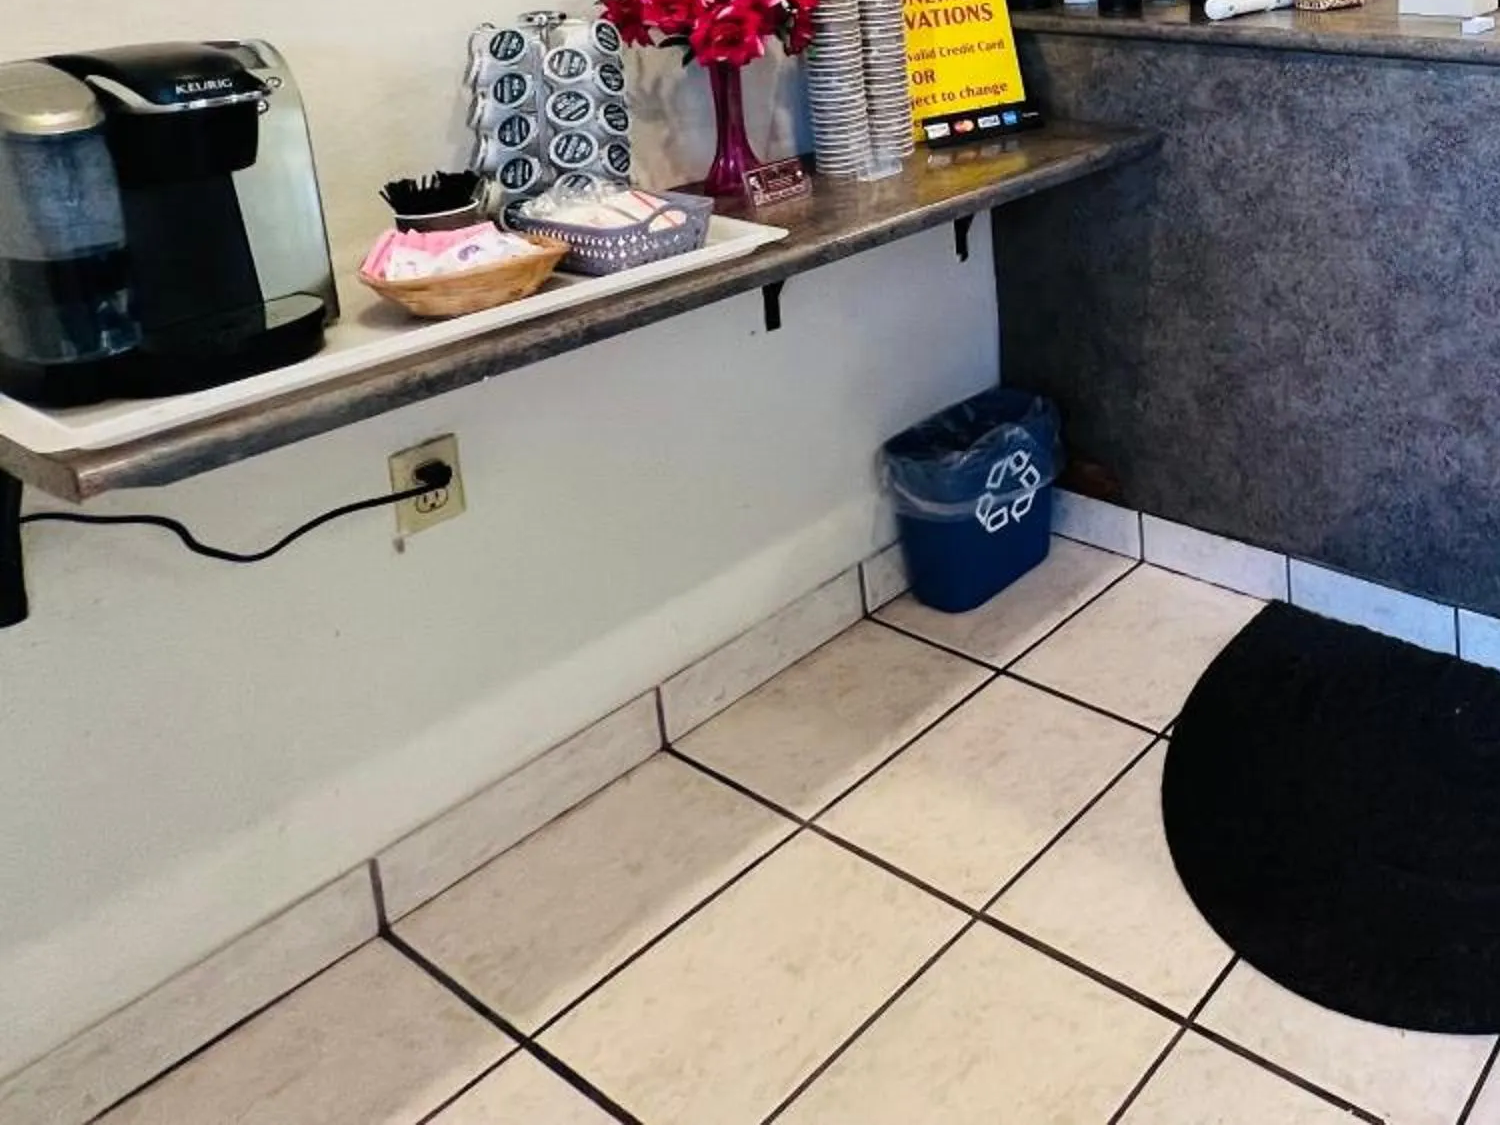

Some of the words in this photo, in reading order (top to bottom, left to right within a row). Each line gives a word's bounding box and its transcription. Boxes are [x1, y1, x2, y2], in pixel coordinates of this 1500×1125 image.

[912, 68, 936, 86] OR
[175, 78, 233, 95] KEURIG
[941, 90, 957, 103] to
[959, 82, 1008, 100] change
